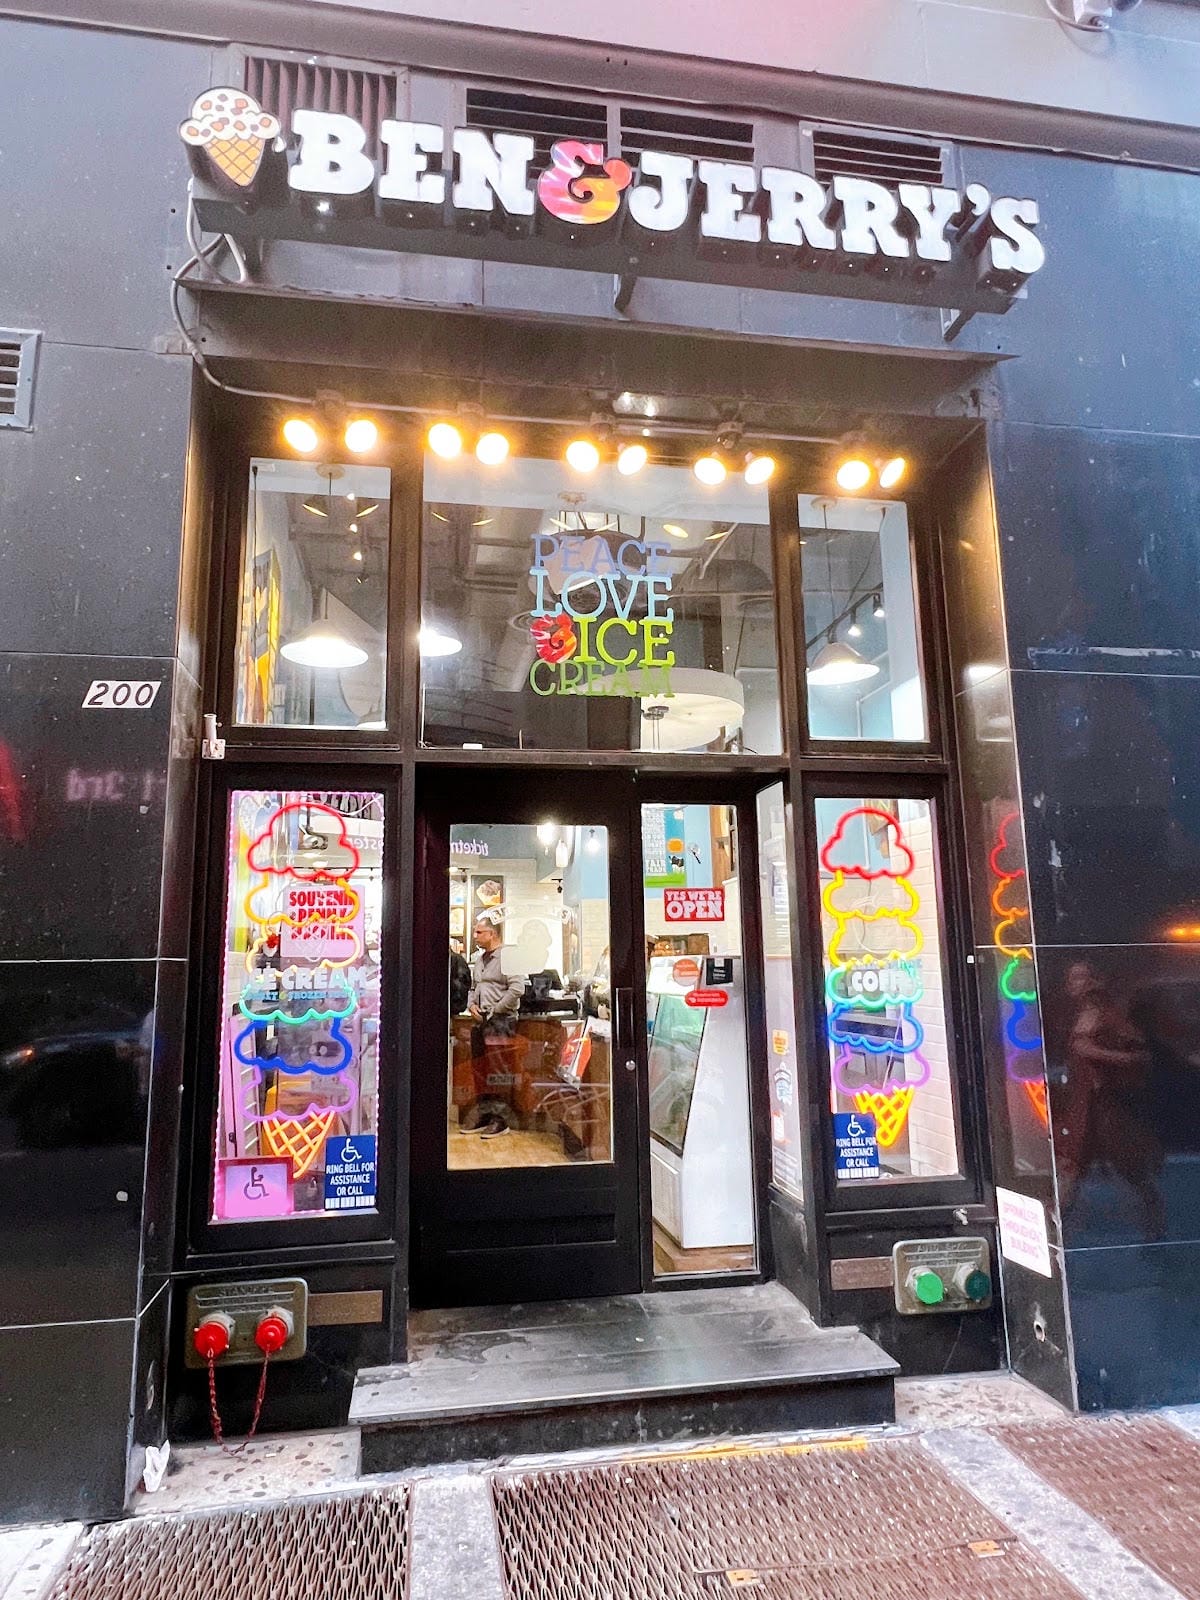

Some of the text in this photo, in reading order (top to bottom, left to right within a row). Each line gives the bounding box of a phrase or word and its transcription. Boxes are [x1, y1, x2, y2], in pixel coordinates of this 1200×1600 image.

[530, 534, 674, 577] PEACE
[529, 568, 675, 622] LOVE
[572, 617, 676, 666] ICE
[529, 660, 676, 699] CREAM
[87, 682, 154, 707] 200
[665, 890, 723, 901] YES WE'RE
[665, 900, 724, 919] OPEN
[281, 966, 370, 990] CREAM
[835, 1137, 877, 1147] RING BELL FOR
[840, 1147, 874, 1157] ASSISTANCE
[326, 1162, 375, 1174] RING BELL FOR
[846, 1157, 869, 1167] OR CALL
[330, 1174, 370, 1185] ASSISTANCE
[336, 1186, 364, 1196] OR CALL
